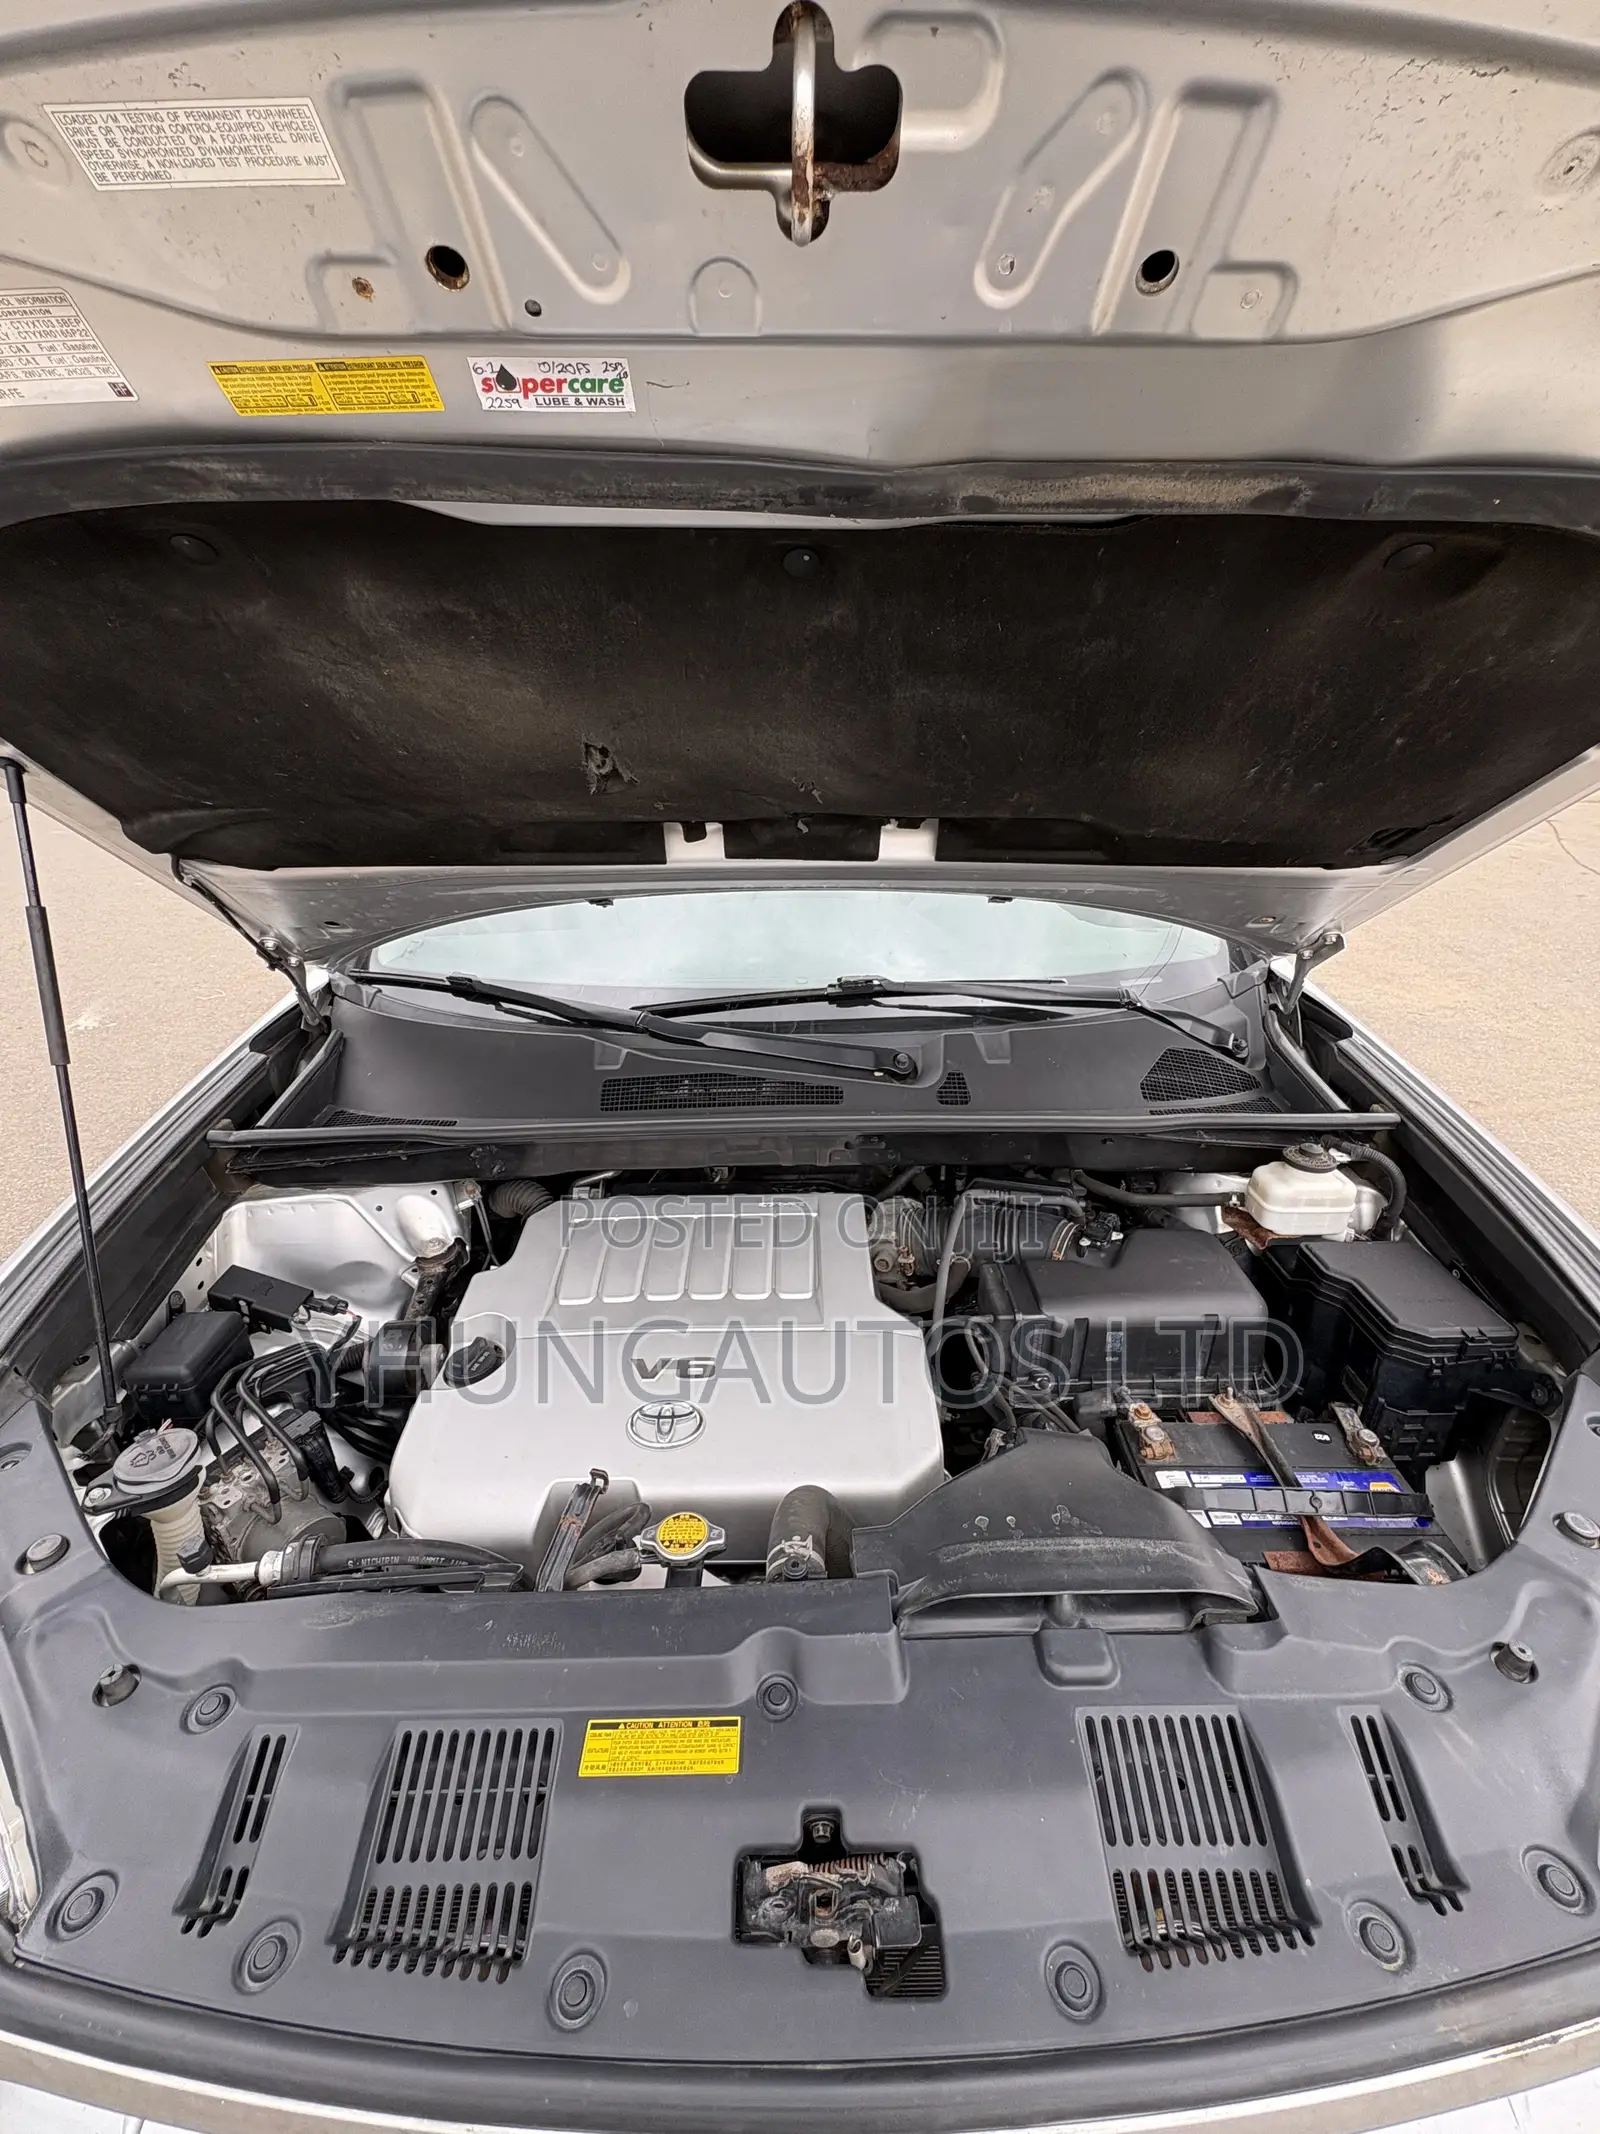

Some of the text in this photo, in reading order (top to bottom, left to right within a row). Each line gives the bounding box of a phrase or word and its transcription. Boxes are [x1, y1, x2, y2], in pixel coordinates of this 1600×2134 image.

[57, 113, 98, 126] LOADED
[120, 111, 164, 124] TESTING
[166, 110, 180, 121] OF
[184, 108, 243, 121] PERMANENT
[245, 107, 310, 120] FOUR-WHEEL
[64, 120, 316, 138] DRIVE OR TRACTION CONTROL-EQUIPPED VEHICLES
[71, 131, 321, 149] MUST BE CONDUCTED ON A FOUR-WHEEL DRIVE
[79, 148, 114, 161] SPEED
[116, 146, 195, 159] SYNCHRONIZED
[147, 159, 155, 169] A
[156, 157, 216, 169] NON-LOADED
[216, 157, 243, 167] TEST
[244, 155, 302, 167] PROCEDURE
[303, 154, 330, 166] MUST
[94, 171, 111, 183] BE
[62, 341, 99, 353] Gasoline
[71, 353, 109, 365] Gasoline
[535, 397, 625, 406] LUBE & WASH
[630, 1356, 716, 1381] V6
[626, 1721, 693, 1730] CAUTION ATTENTION
